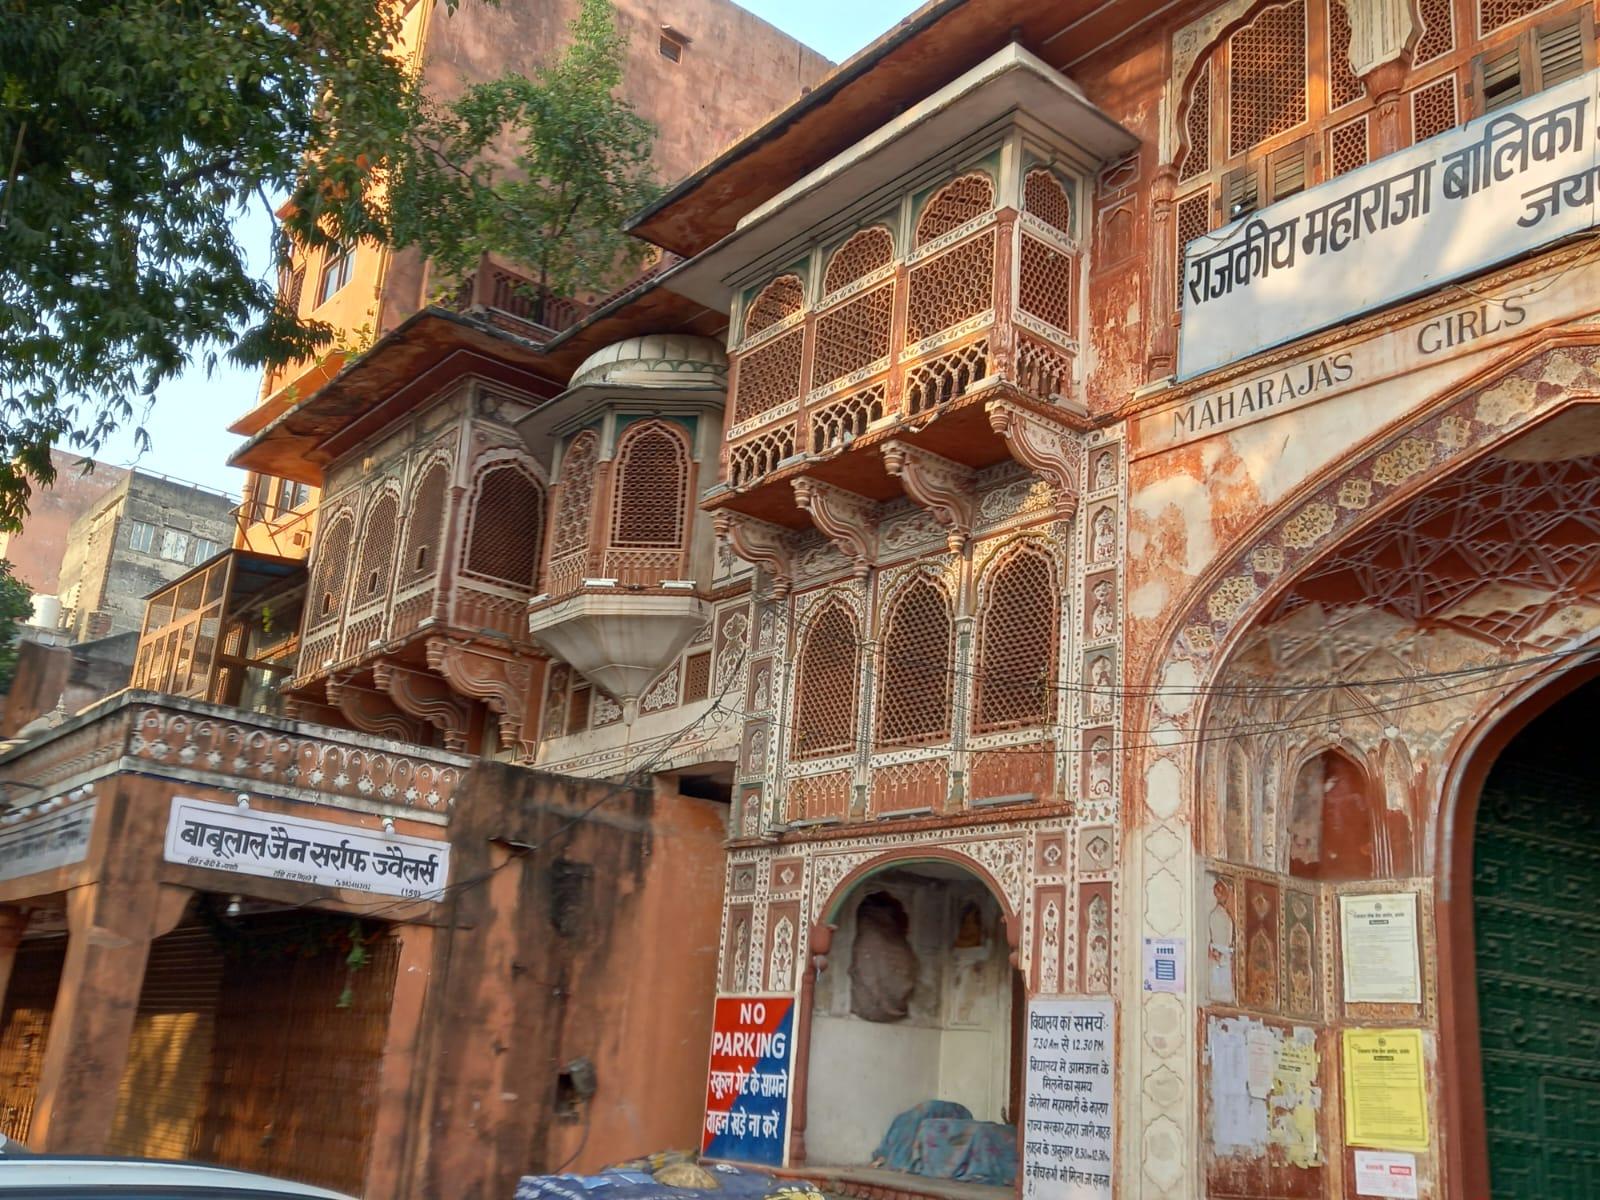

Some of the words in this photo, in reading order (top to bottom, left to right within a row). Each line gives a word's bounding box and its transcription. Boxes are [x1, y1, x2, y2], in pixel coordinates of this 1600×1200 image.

[1187, 217, 1301, 307] राजकीय
[1302, 159, 1437, 258] महाराजा
[1442, 96, 1591, 200] बालिका
[1516, 164, 1600, 229] जय
[1417, 295, 1527, 355] GIRLS
[180, 819, 269, 861] बाबूलाल
[267, 826, 311, 864] जैन
[309, 839, 370, 872] सर्राफ
[372, 846, 439, 886] ज्वैलर्स
[739, 1002, 766, 1025] NO
[1030, 1011, 1059, 1034] विद्यालय
[712, 1031, 786, 1059] PARKING
[710, 1070, 734, 1099] स्कूल
[735, 1065, 751, 1095] गेट
[750, 1067, 760, 1096] के
[760, 1069, 788, 1099] सामने
[1029, 1055, 1058, 1075] विद्यालय
[1100, 1060, 1110, 1075] के
[706, 1110, 730, 1136] वाहन
[731, 1106, 747, 1140] खड़े
[748, 1113, 761, 1138] ना
[762, 1109, 780, 1139] करें
